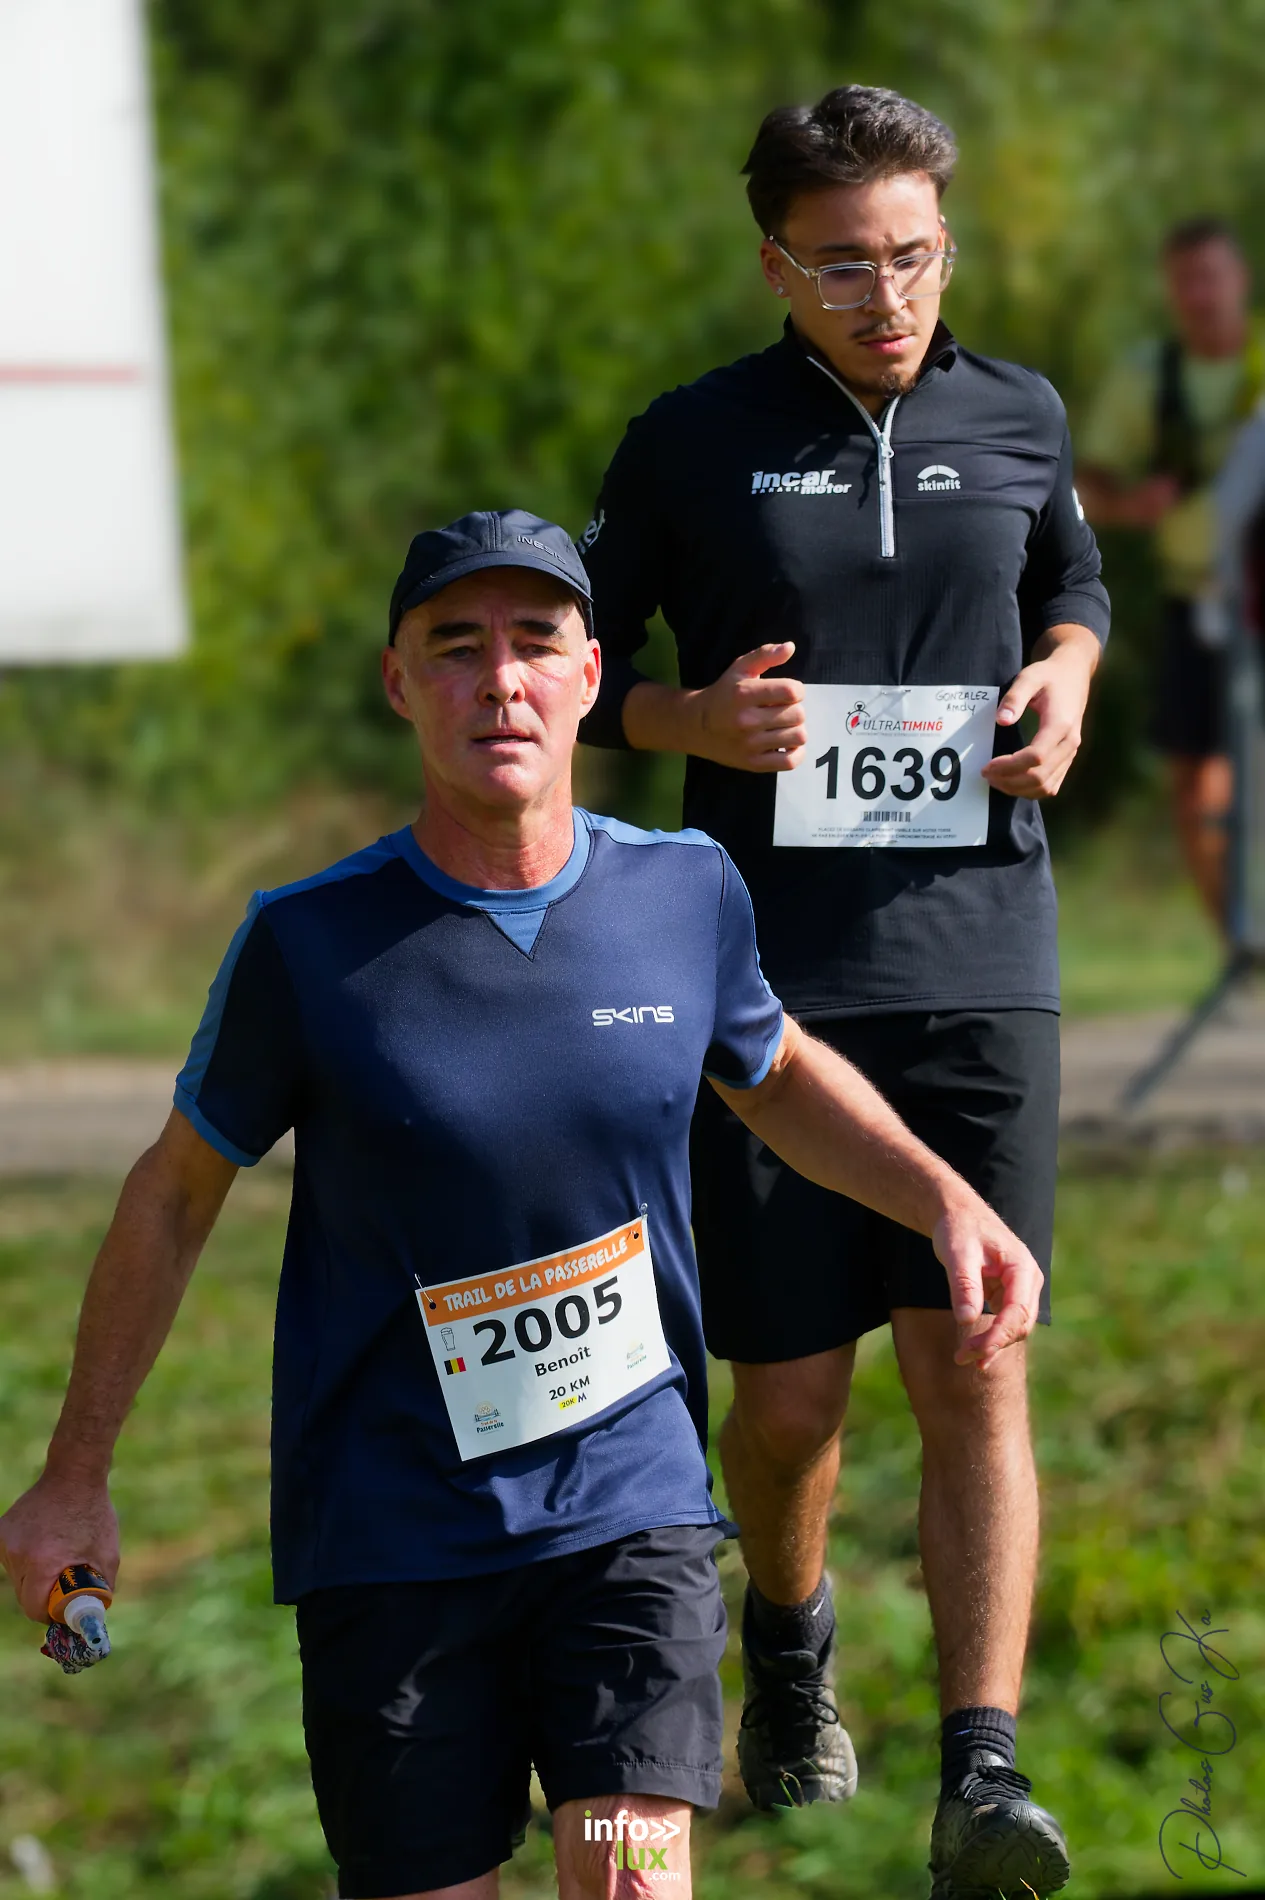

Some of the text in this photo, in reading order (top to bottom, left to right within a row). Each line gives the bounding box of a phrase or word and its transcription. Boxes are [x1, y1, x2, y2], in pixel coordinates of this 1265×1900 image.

[752, 470, 836, 489] incar
[800, 483, 852, 494] motor
[918, 480, 961, 491] skinfit
[936, 690, 990, 701] GONZALEZ
[863, 720, 943, 731] ULTRATIMING
[815, 746, 961, 801] 1639
[443, 1236, 628, 1312] TRAIL DE LA PASSERELLE
[472, 1276, 623, 1366] 2005
[534, 1346, 591, 1377] Benoît
[549, 1375, 590, 1401] 20 KM
[578, 1392, 587, 1403] M
